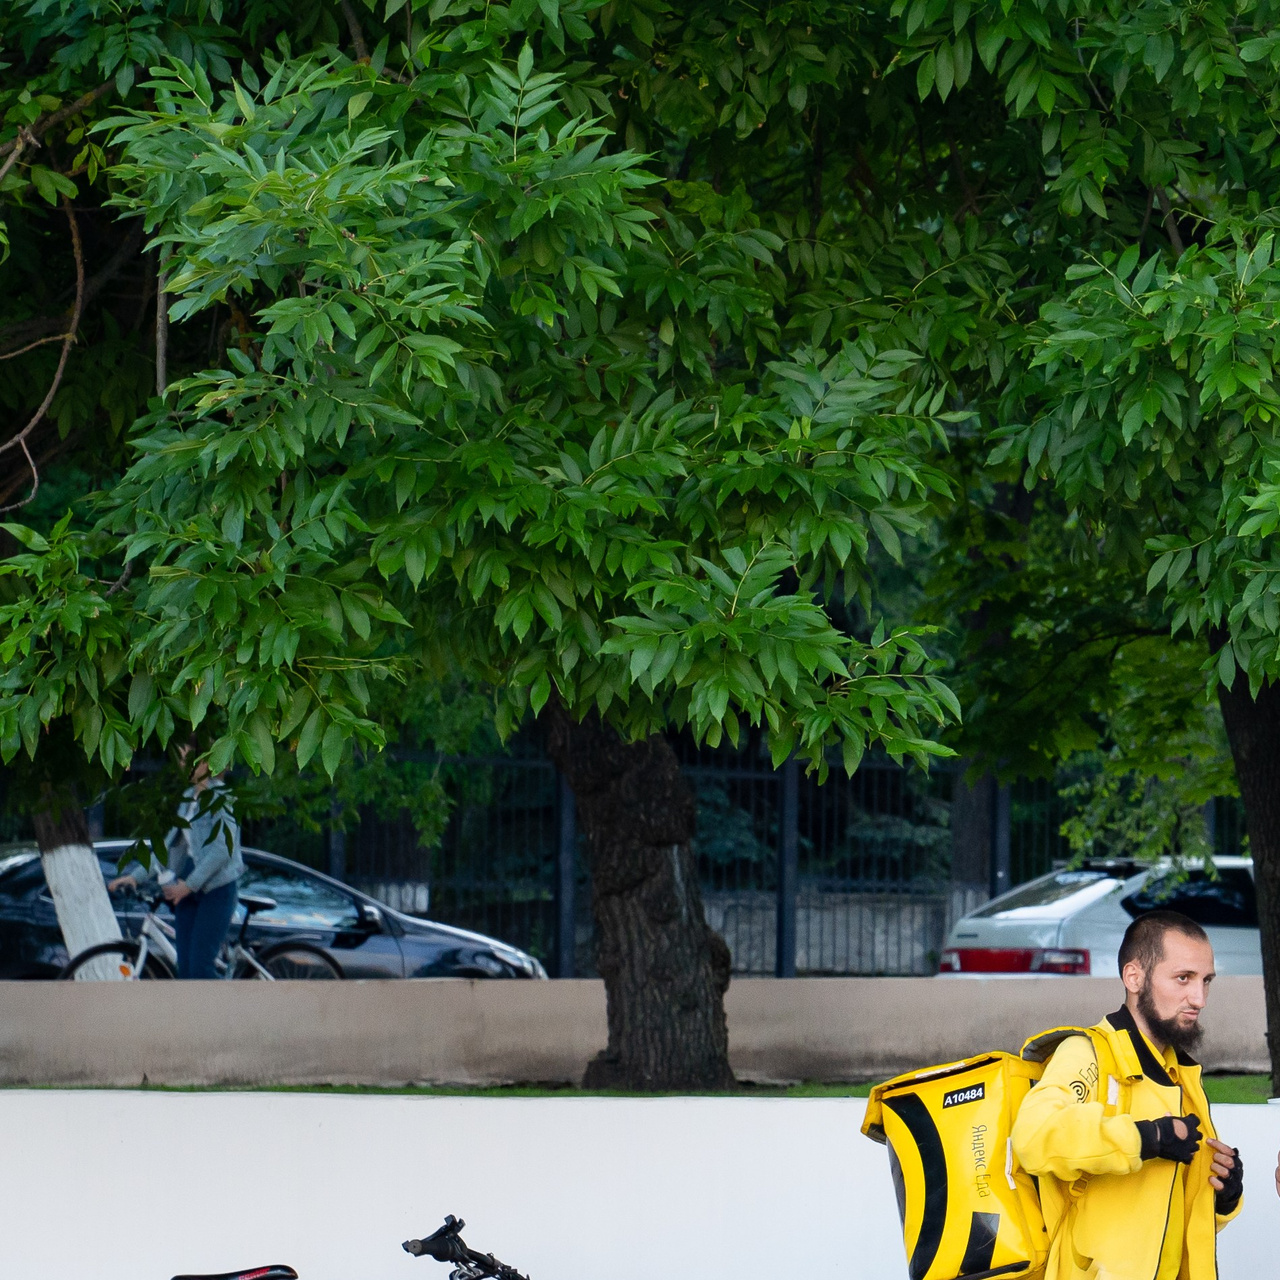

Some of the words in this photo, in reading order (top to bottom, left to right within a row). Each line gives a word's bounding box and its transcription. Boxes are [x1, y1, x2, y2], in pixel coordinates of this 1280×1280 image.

[944, 1087, 983, 1106] A10484
[971, 1124, 988, 1171] Яндекс
[975, 1173, 991, 1198] Еда
